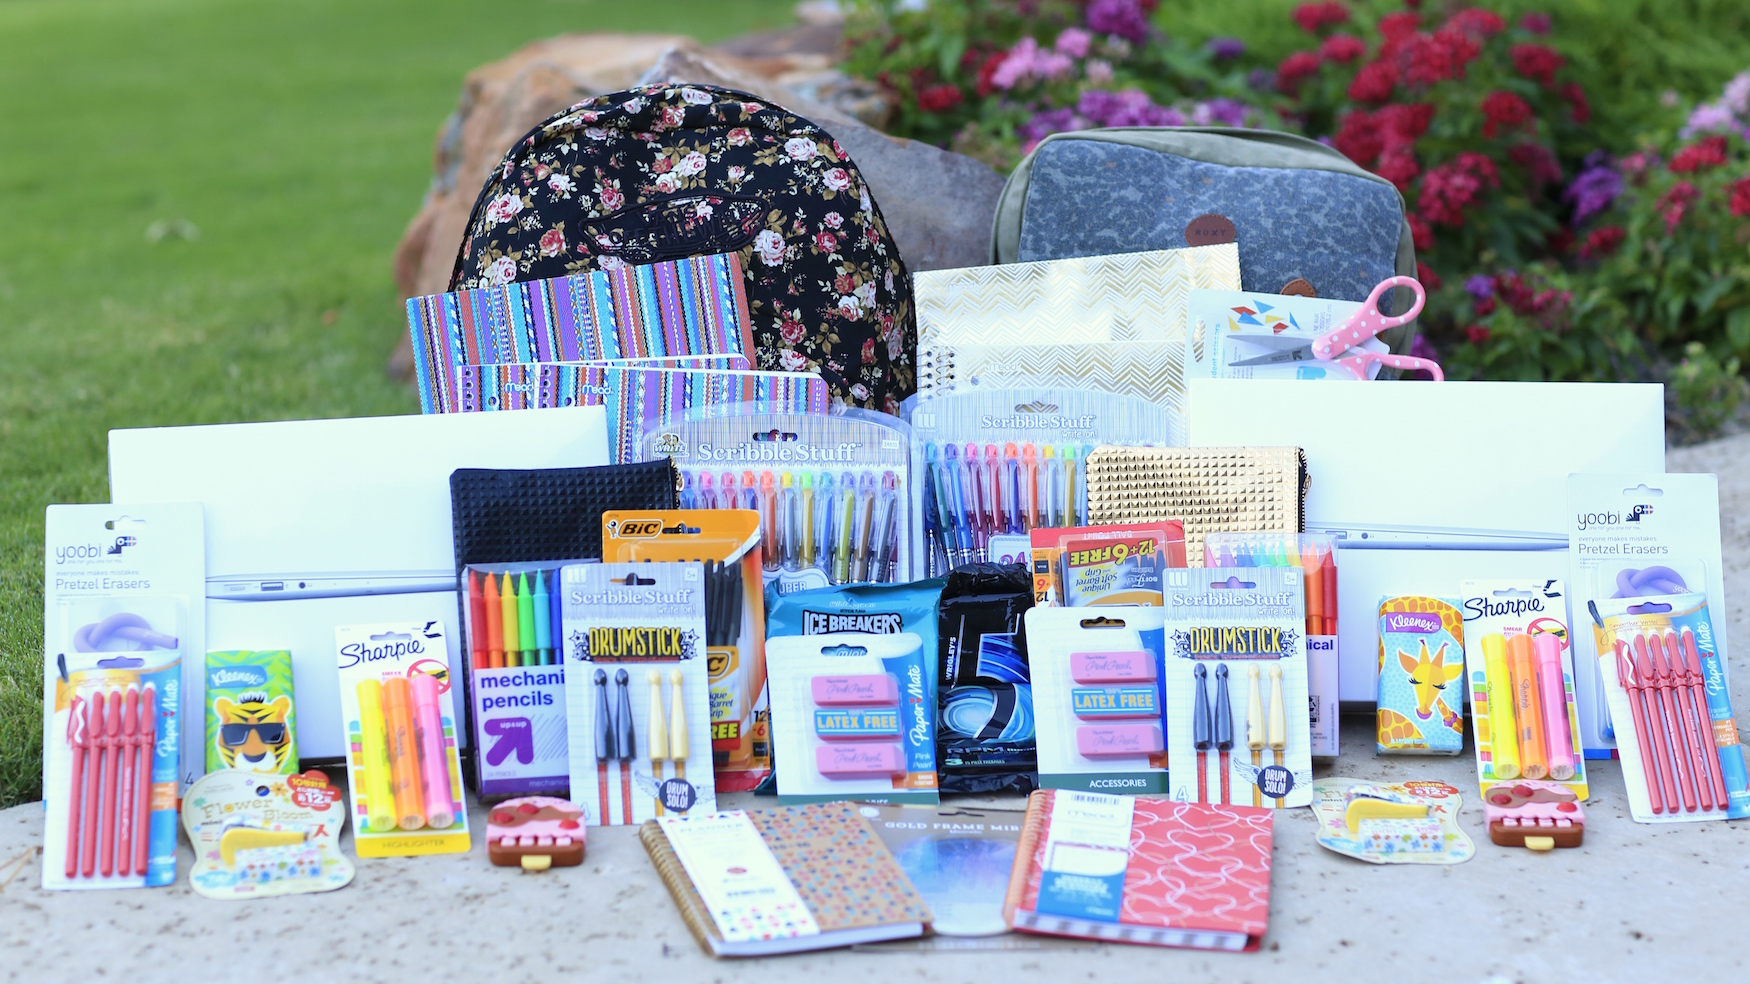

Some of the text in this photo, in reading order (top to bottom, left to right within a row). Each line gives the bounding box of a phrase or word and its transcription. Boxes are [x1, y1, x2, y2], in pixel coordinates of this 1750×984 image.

[1195, 228, 1226, 237] ROXY
[1210, 322, 1221, 379] dent scissors
[989, 362, 1018, 371] mead
[581, 384, 611, 395] mead
[981, 415, 1094, 429] Scribble Stuff
[1061, 429, 1098, 438] write on!
[697, 442, 856, 461] Scribble Stuff
[1577, 510, 1621, 531] yoobi
[56, 543, 102, 565] yoobi
[1578, 543, 1669, 554] Pretzel Erasers
[1070, 546, 1112, 566] FREE
[1085, 567, 1102, 577] Grip
[1286, 575, 1295, 583] 5+
[55, 577, 151, 590] Pretzel Erasers
[1076, 572, 1118, 587] Soft Barrel
[779, 581, 807, 594] UPER
[1081, 582, 1111, 593] Unique
[571, 589, 691, 606] Scribble Stuff
[1172, 592, 1292, 607] Scribble Stuff
[658, 605, 696, 614] write on!
[1257, 606, 1295, 615] write on!
[1463, 597, 1545, 622] Sharpie
[803, 610, 902, 635] ICE BREAKERS
[1389, 614, 1434, 631] Kleenex
[589, 626, 682, 657] DRUMSTICK
[1190, 626, 1282, 655] DRUMSTICK
[1306, 638, 1334, 651] ical
[338, 638, 425, 669] Sharpie
[945, 636, 957, 681] WRIGLEY'S
[1698, 621, 1725, 696] Paper Mate
[211, 669, 258, 687] Kleenex
[481, 669, 565, 689] mechani
[161, 678, 179, 712] Mate
[482, 690, 554, 712] pencils
[709, 691, 728, 702] ique
[1074, 694, 1154, 708] LATEX FREE
[907, 664, 930, 747] Paper Mate
[500, 721, 527, 729] up&up
[817, 715, 898, 729] LATEX FREE
[156, 715, 179, 758] Paper
[915, 752, 932, 760] Pink
[913, 761, 933, 769] Pearl
[1265, 769, 1287, 782] DRUM
[528, 778, 569, 788] mechanic
[666, 781, 689, 795] DRUM
[1089, 778, 1147, 789] ACCESSORIES
[1264, 781, 1286, 794] SOLO!
[666, 794, 688, 809] SOLO!
[884, 821, 928, 829] GOLD
[932, 822, 985, 831] FRAME
[990, 824, 1023, 832] MIR
[382, 839, 445, 849] HIGHLIGHTER
